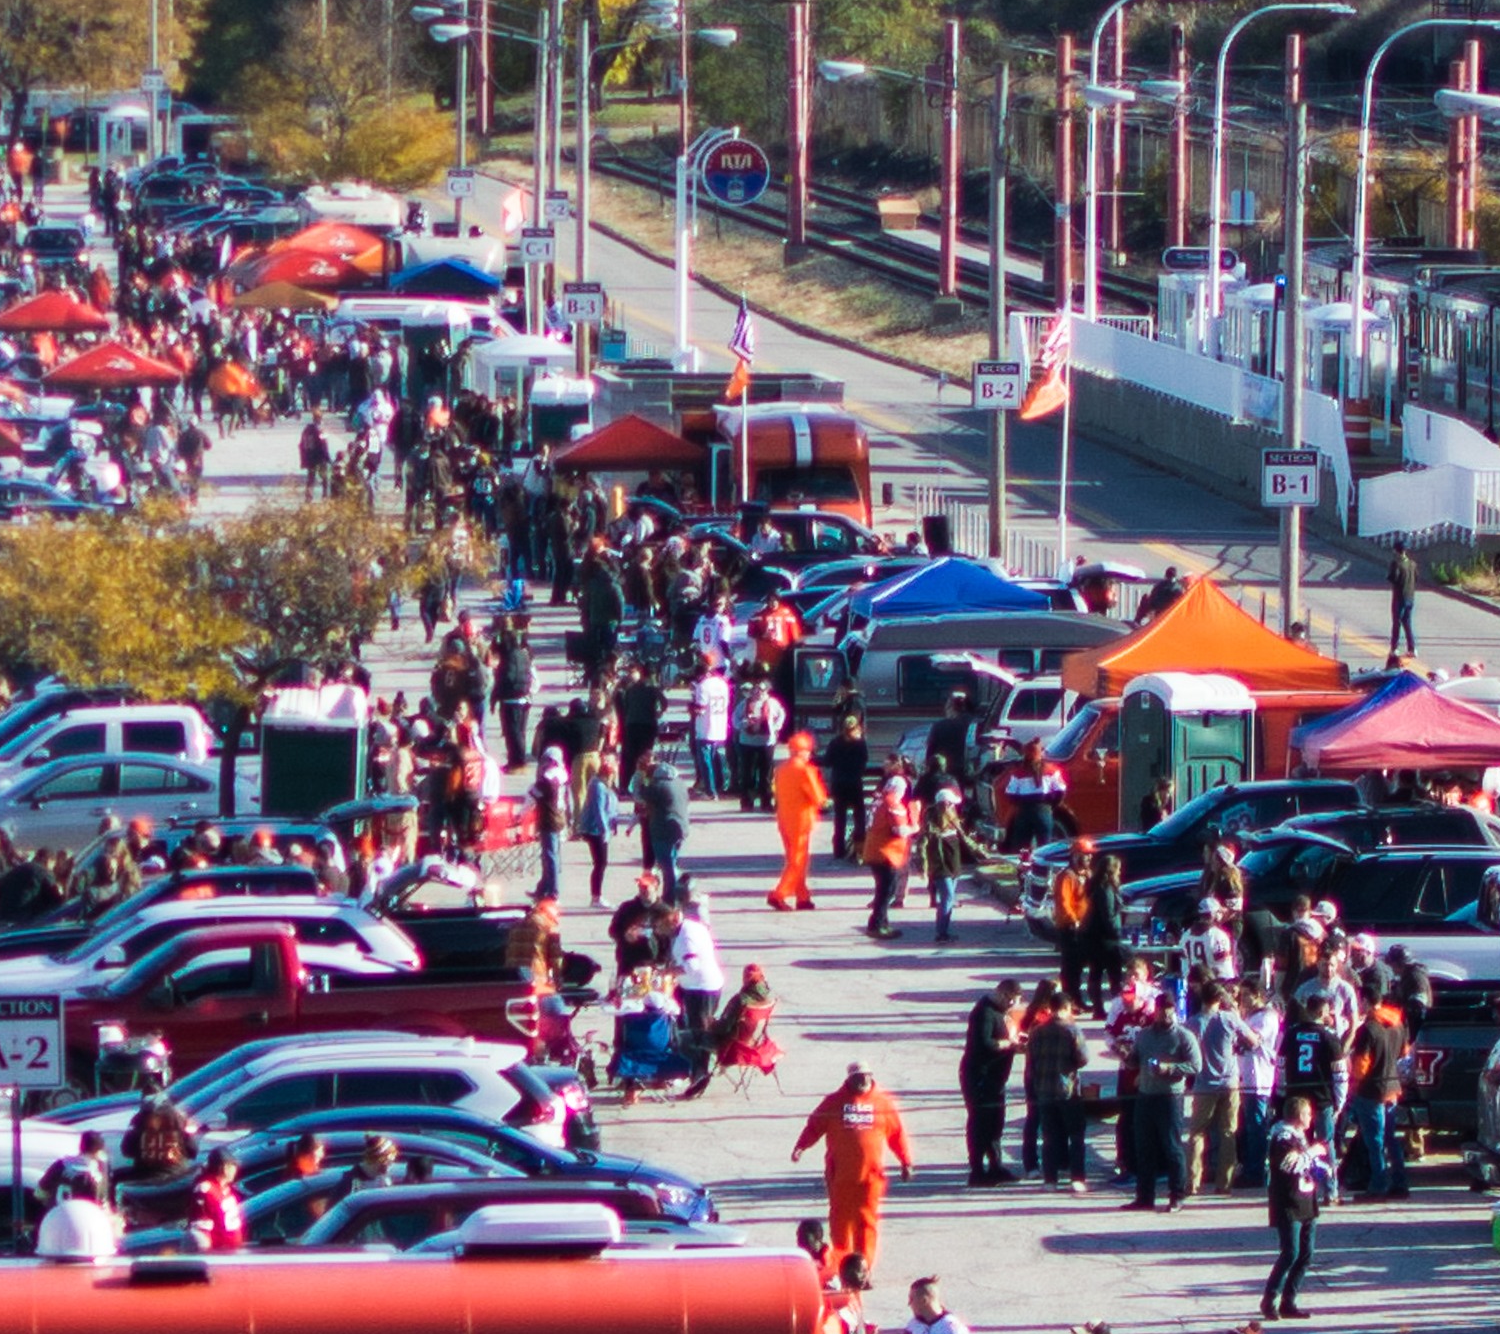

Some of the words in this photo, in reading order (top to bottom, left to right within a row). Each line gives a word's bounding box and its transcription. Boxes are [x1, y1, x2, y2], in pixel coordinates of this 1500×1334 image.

[568, 298, 597, 315] B-3
[981, 382, 1016, 400] B-2
[1269, 453, 1316, 464] SECTION
[1272, 474, 1311, 496] B-1
[1297, 1043, 1314, 1073] 2
